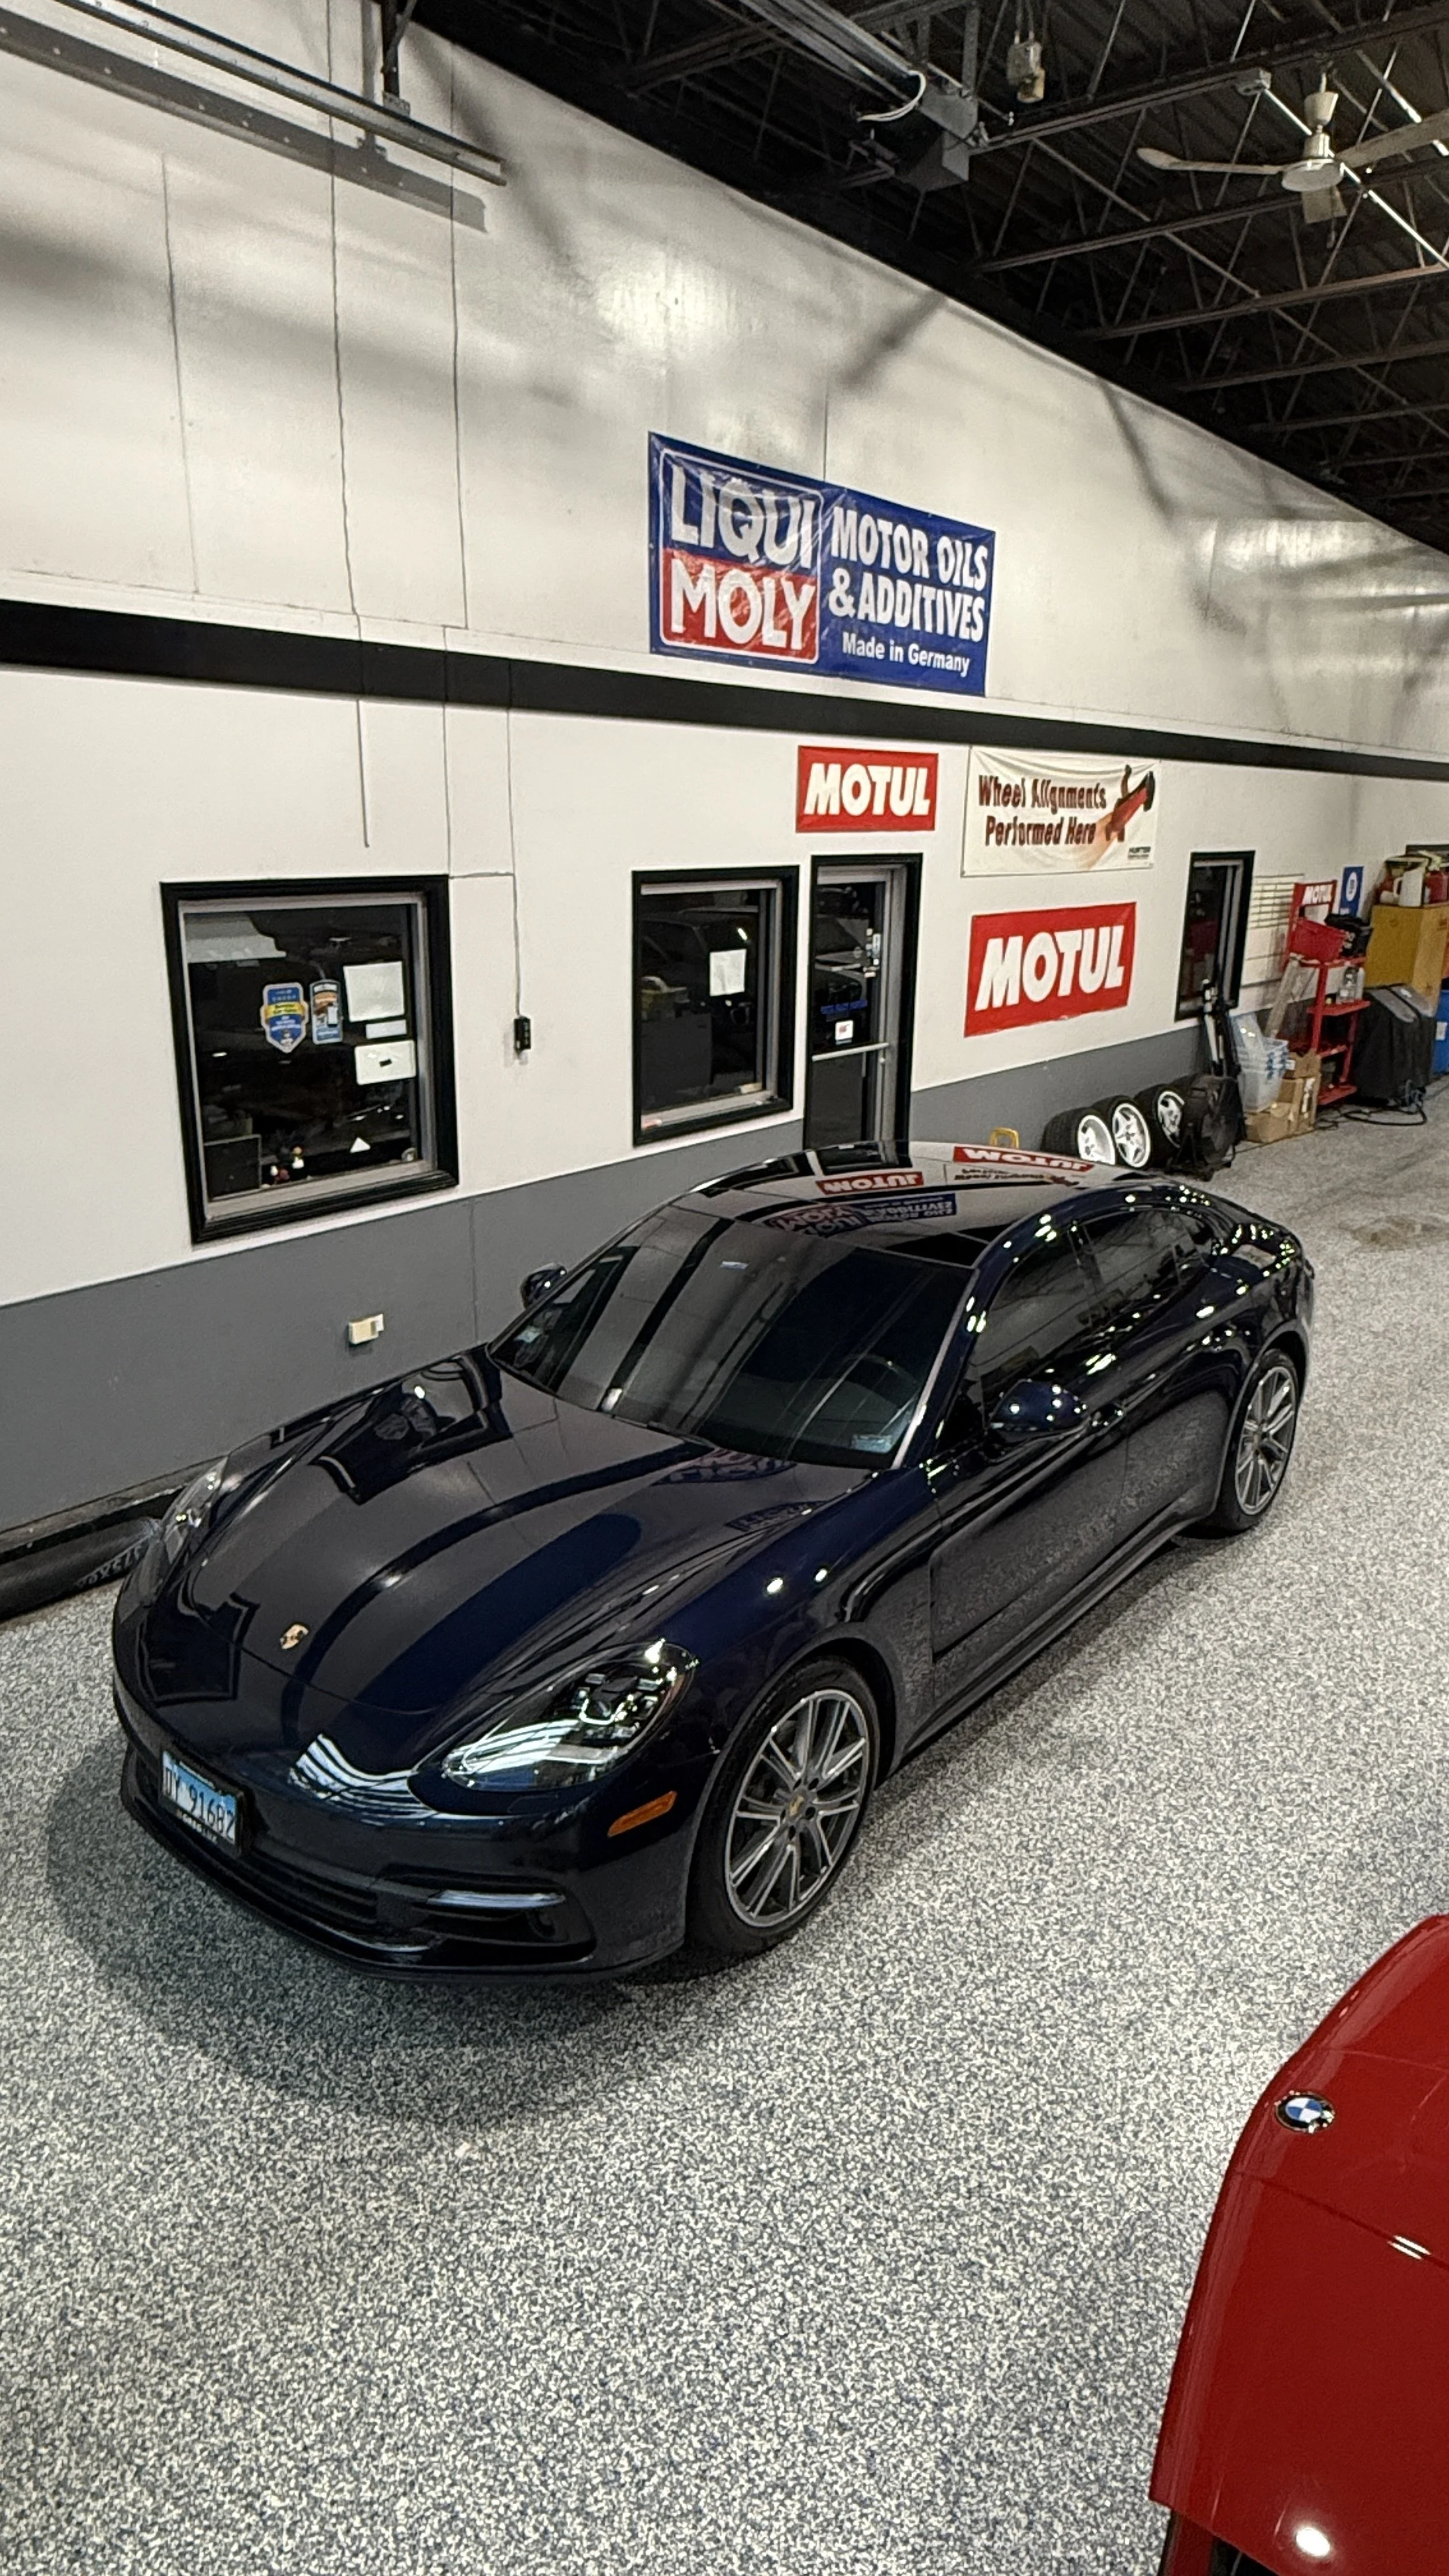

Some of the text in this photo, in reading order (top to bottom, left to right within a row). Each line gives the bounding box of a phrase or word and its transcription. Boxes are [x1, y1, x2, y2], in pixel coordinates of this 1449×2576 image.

[671, 464, 815, 569] LIQUI
[831, 507, 988, 592] MOTOR OILS
[671, 558, 816, 650] MOLY
[842, 631, 970, 677] Made in Germany
[804, 763, 930, 816] MOTUL
[979, 774, 1107, 815] Wheel Alignments
[986, 815, 1097, 847] Performed Here
[974, 925, 1124, 1011] MOTUL
